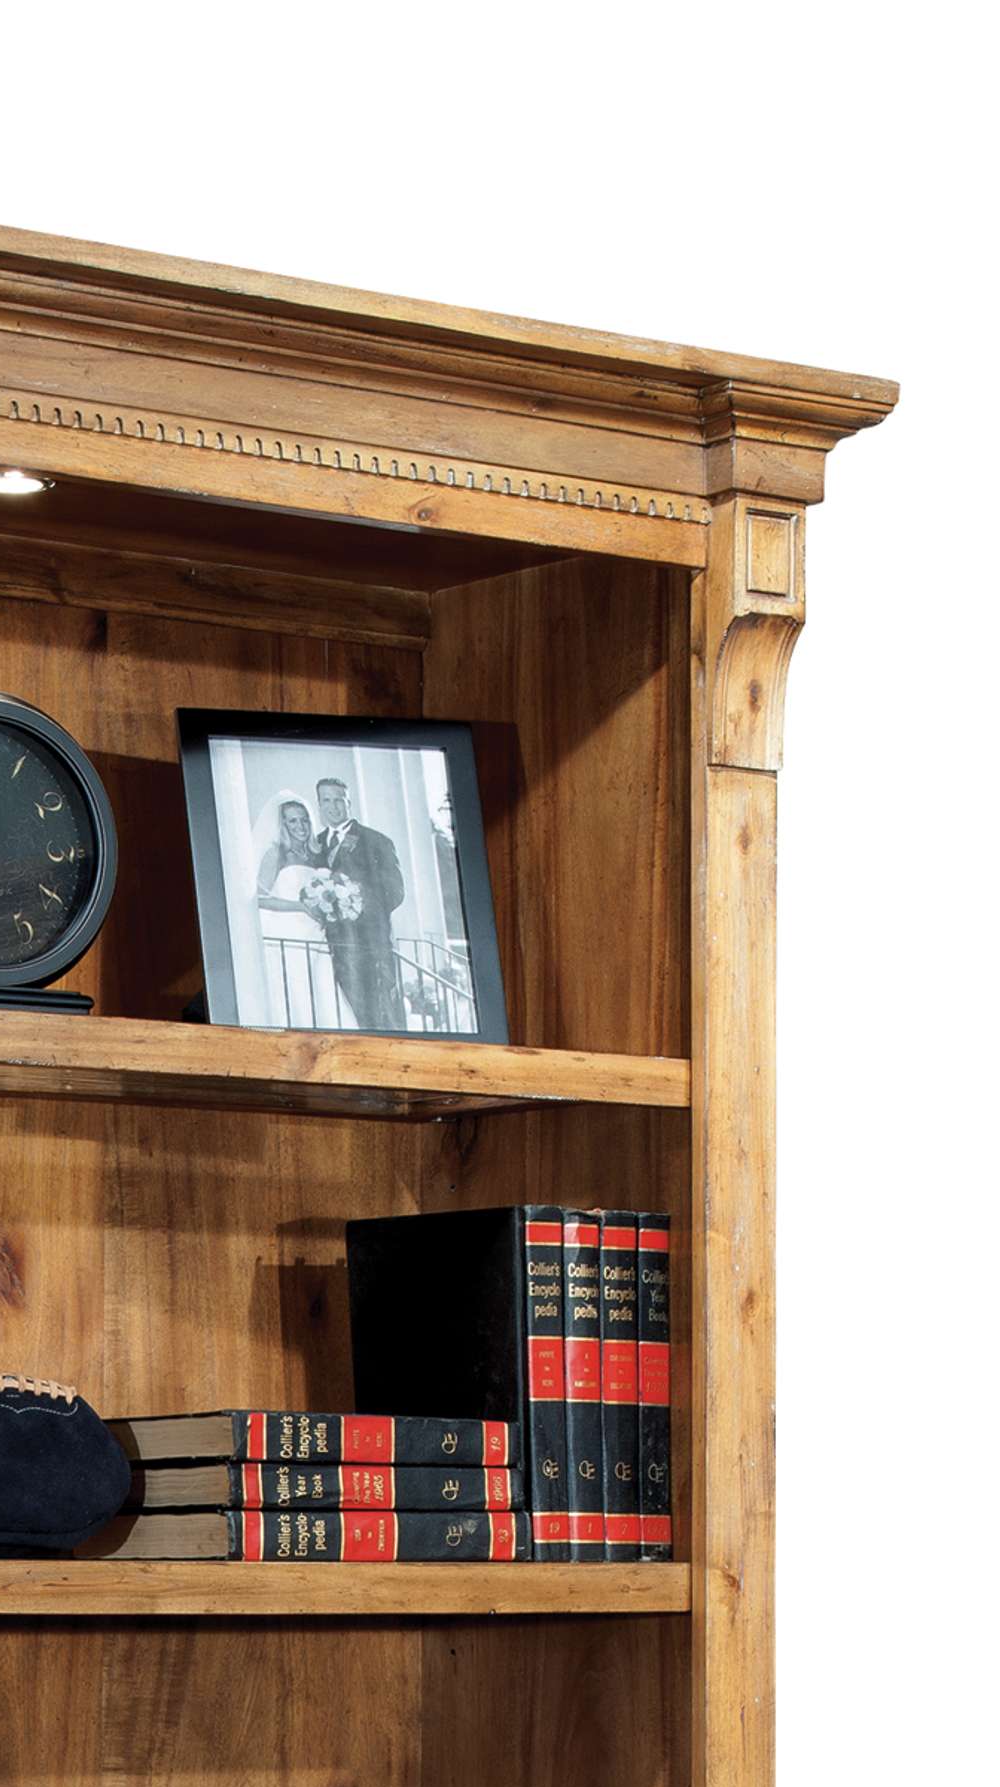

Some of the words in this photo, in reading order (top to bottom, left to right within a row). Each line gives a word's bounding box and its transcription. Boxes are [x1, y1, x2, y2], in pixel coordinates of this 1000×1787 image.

[11, 756, 26, 778] 1
[34, 791, 63, 820] 2
[47, 840, 74, 863] 3
[39, 884, 63, 909] 4
[13, 912, 34, 945] 5
[528, 1262, 561, 1277] Collier's
[535, 1302, 558, 1318] pedia
[609, 1307, 633, 1322] pedia
[280, 1415, 293, 1459] Collier's
[314, 1422, 328, 1453] pedia
[277, 1466, 290, 1506] Collier's
[295, 1474, 307, 1497] Year
[312, 1473, 323, 1499] Book
[277, 1514, 291, 1557] Collier's
[312, 1519, 327, 1551] pedia
